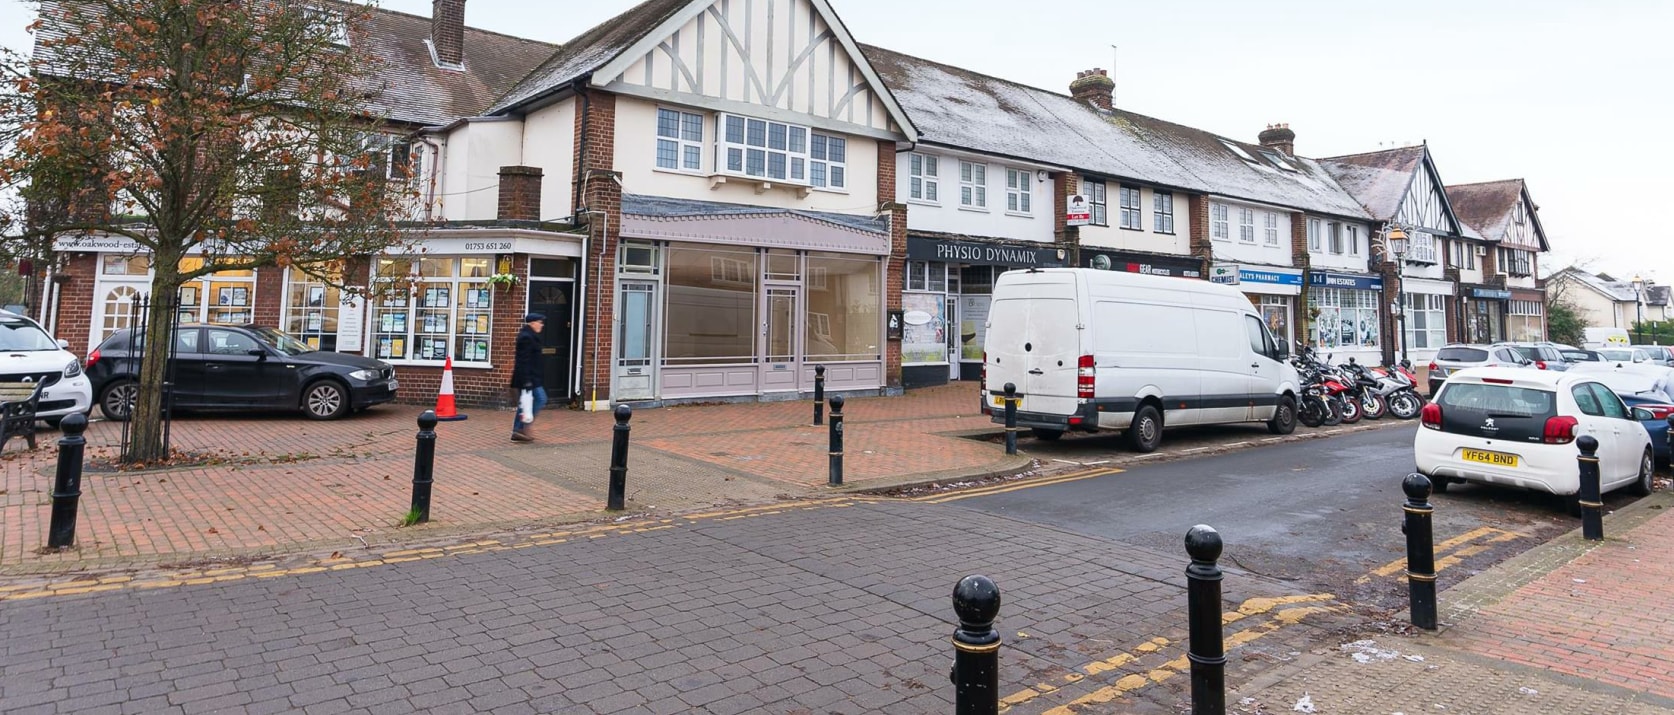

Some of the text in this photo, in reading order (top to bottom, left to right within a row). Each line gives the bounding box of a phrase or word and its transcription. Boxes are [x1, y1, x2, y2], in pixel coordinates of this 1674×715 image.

[937, 244, 1036, 264] PHYSIO DYNAMIX
[1211, 276, 1235, 284] CHEMIST
[1256, 274, 1279, 282] PHARMACY
[1466, 451, 1513, 465] YF64 BND
